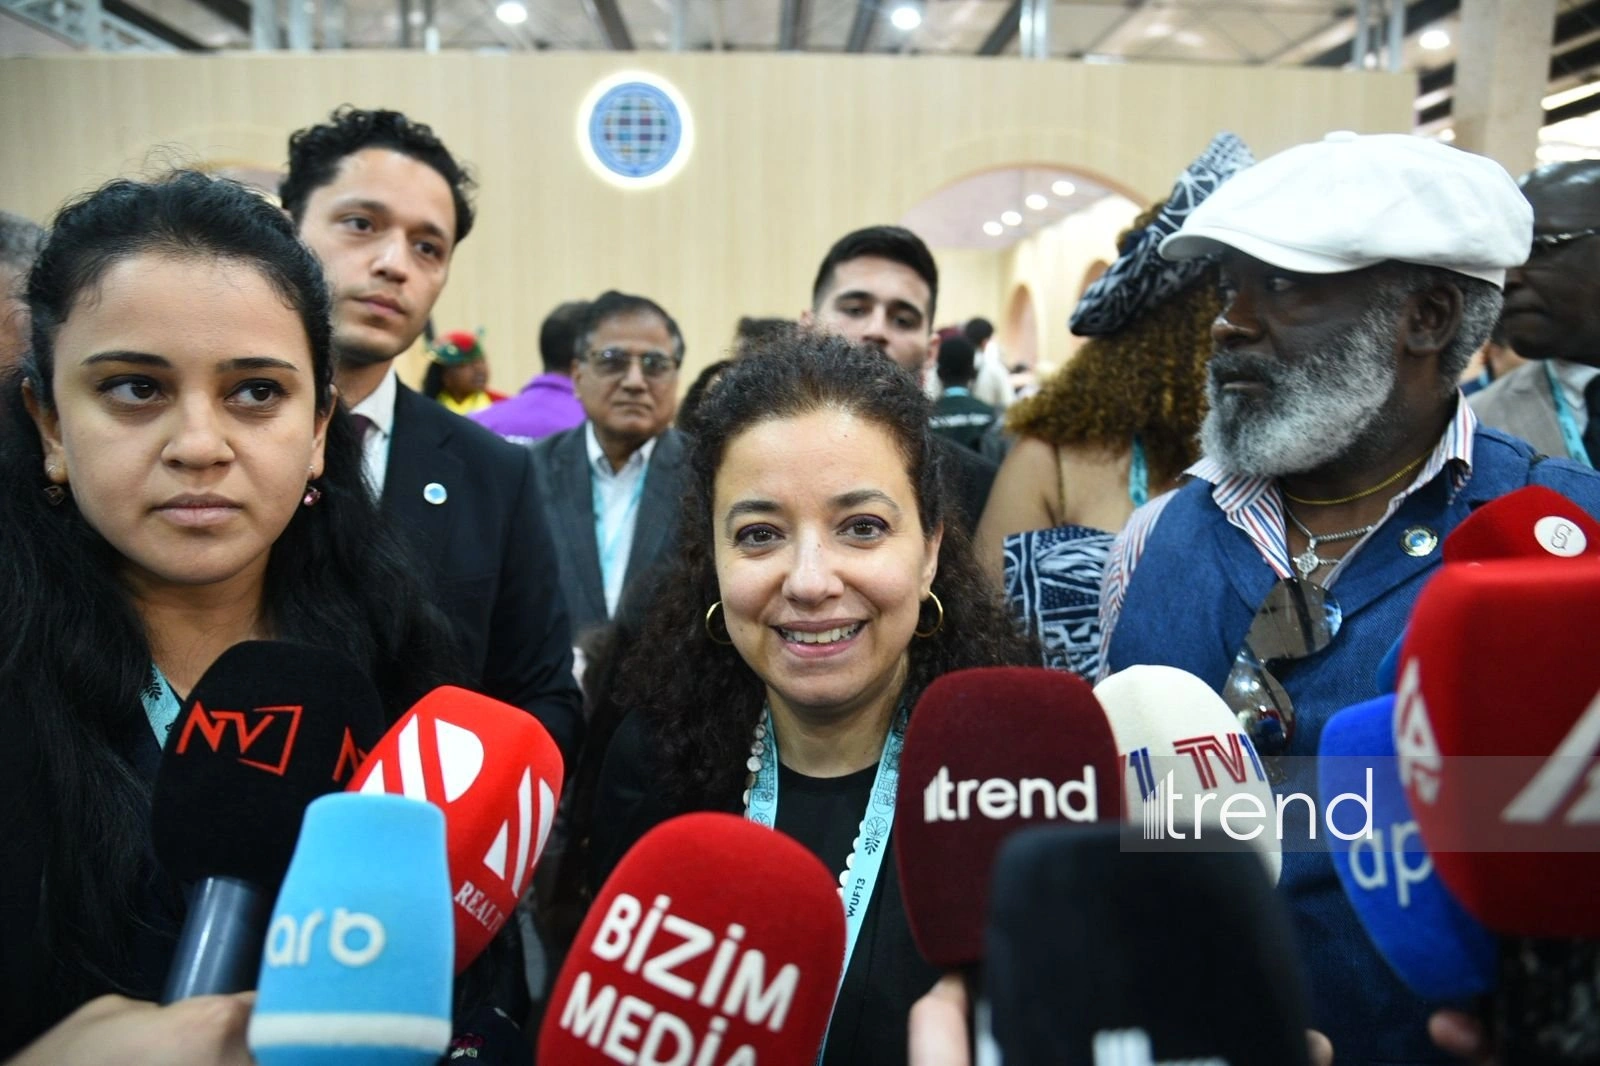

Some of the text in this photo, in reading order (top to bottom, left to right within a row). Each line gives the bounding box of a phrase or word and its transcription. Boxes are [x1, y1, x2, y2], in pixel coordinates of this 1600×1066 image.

[1172, 732, 1265, 790] TV1
[936, 765, 1098, 823] trend
[454, 880, 496, 927] REAL
[846, 877, 866, 918] WUF13
[591, 892, 799, 1033] BİZİM
